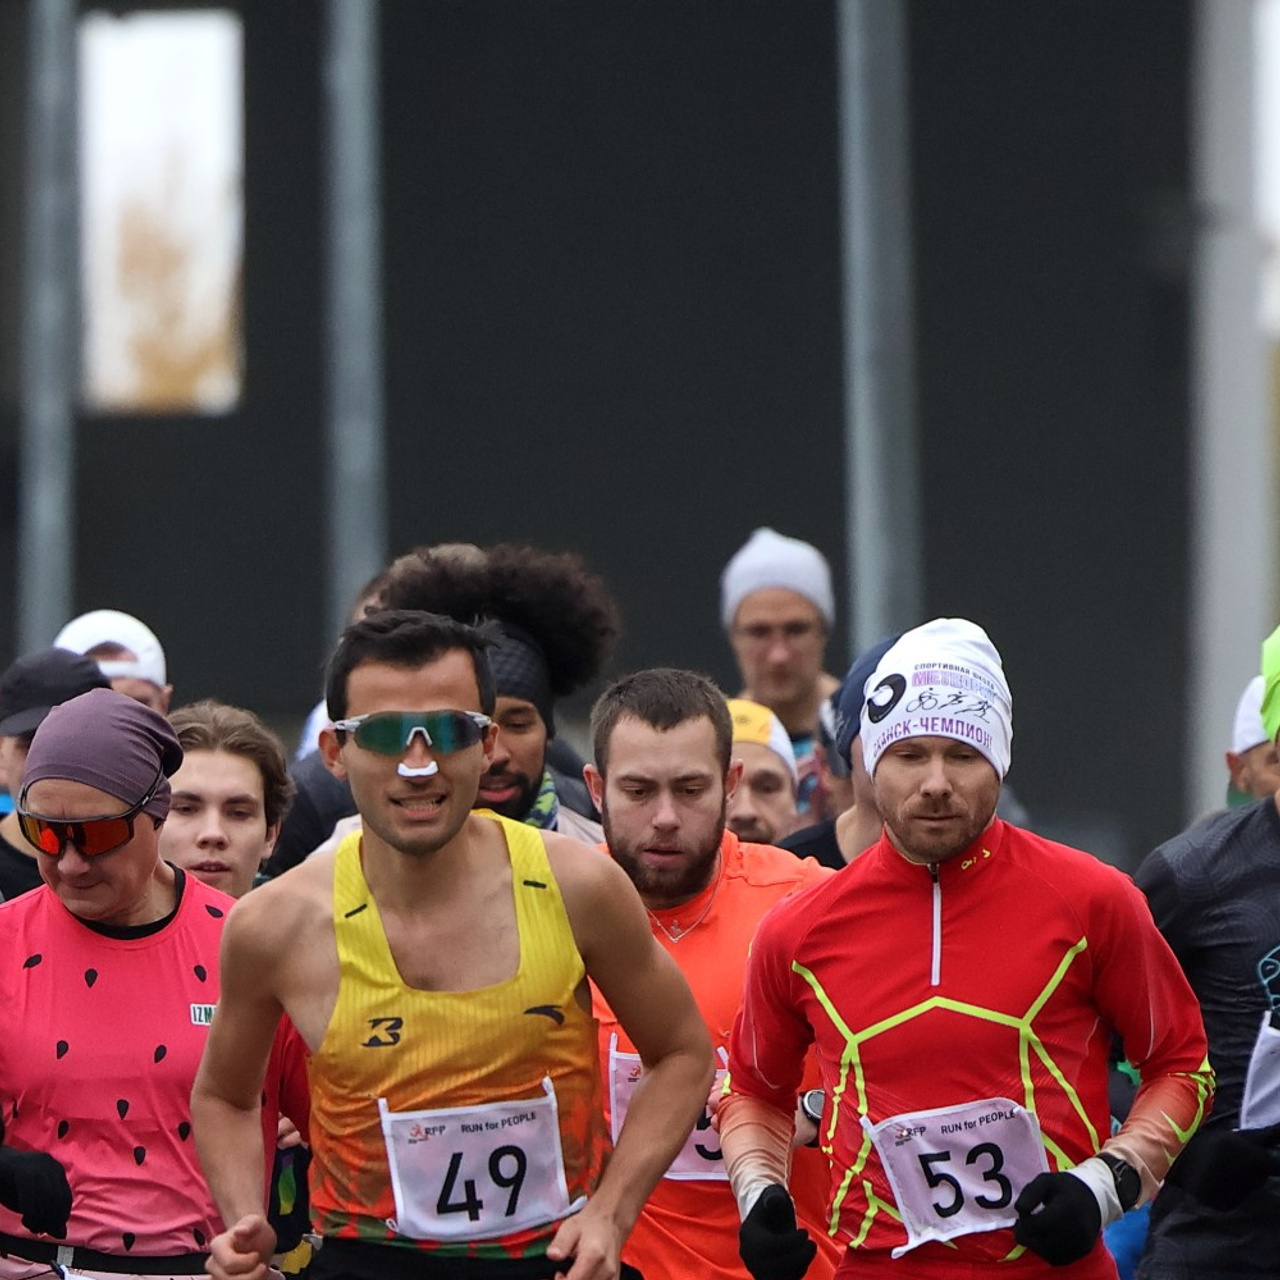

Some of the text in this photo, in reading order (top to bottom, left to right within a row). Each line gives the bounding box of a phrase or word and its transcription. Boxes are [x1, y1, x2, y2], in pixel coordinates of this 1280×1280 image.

[914, 662, 970, 675] СПОРТИВНАЯ
[461, 1123, 483, 1134] RUN
[485, 1121, 499, 1131] for
[501, 1111, 537, 1129] PEOPLE
[940, 1123, 962, 1135] RUN
[964, 1119, 977, 1130] for
[979, 1108, 1016, 1126] PEOPLE
[436, 1145, 527, 1221] 49
[917, 1142, 1013, 1218] 53
